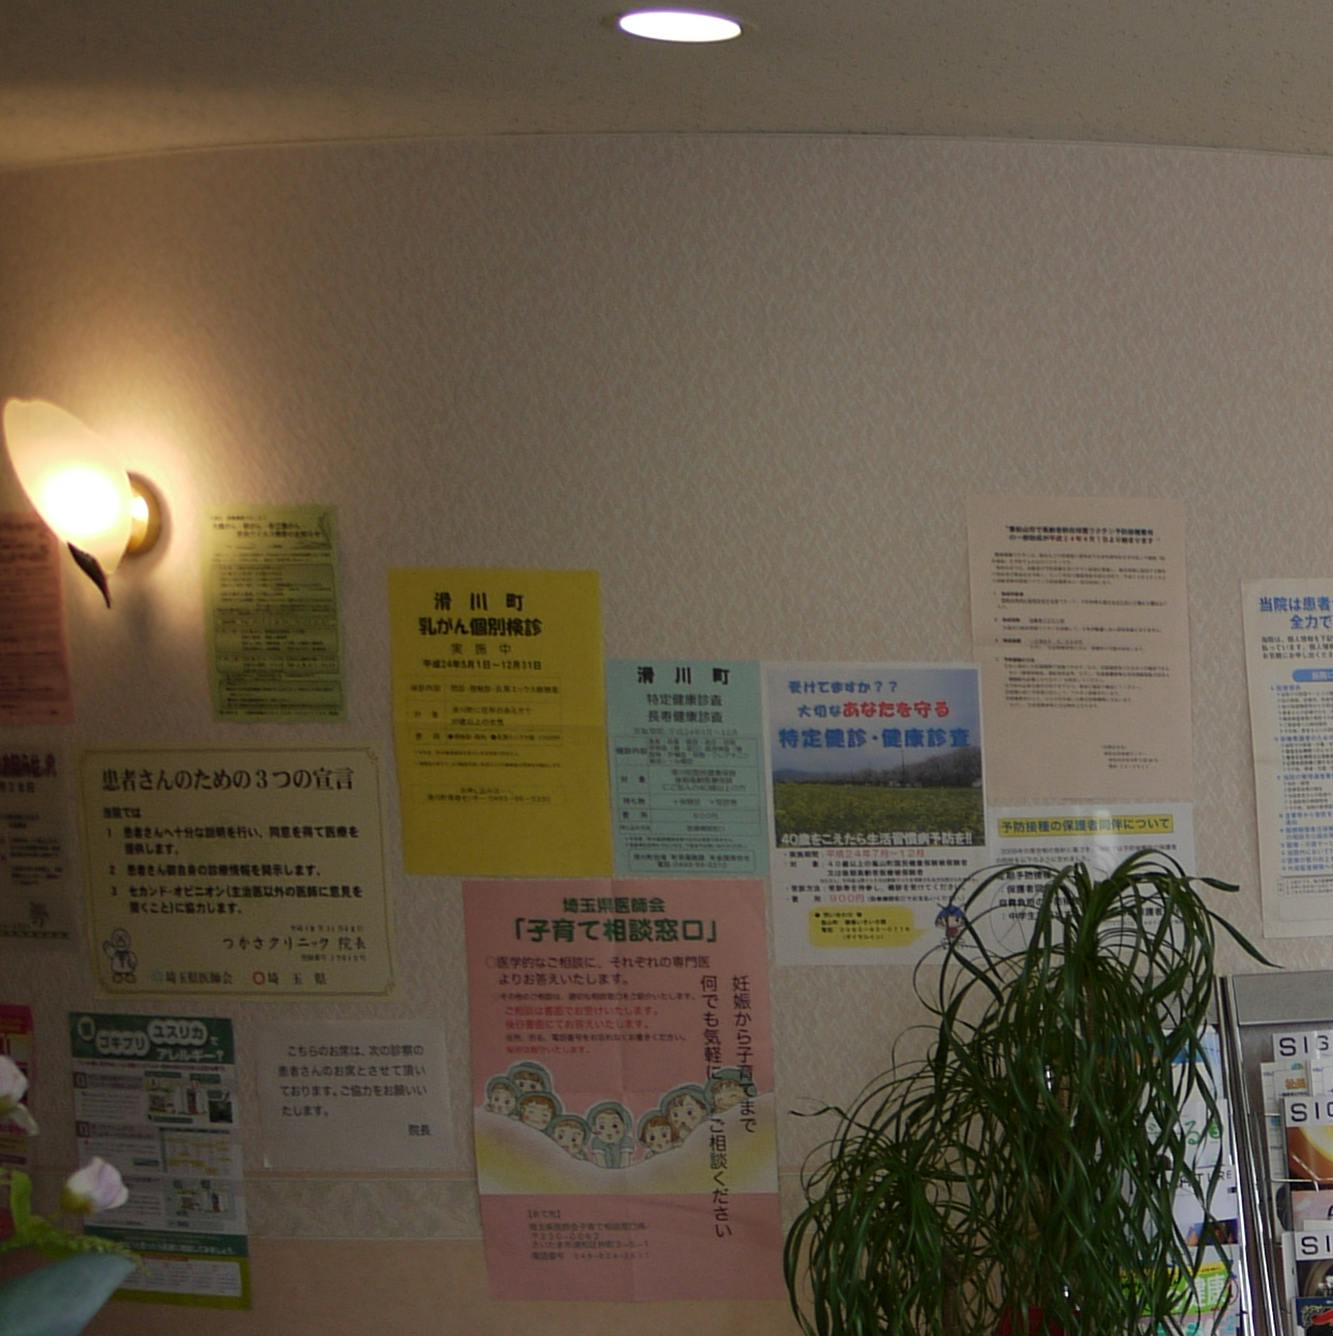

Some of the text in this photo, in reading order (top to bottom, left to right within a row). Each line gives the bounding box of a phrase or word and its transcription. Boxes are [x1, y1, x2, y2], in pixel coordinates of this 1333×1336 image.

[434, 592, 525, 611] 滑川町
[418, 617, 544, 636] 乳がん個別検診
[637, 666, 730, 685] 滑川町
[797, 700, 950, 719] 大切なあなたを守る
[778, 727, 971, 749] 特定健診・健康診査
[563, 896, 666, 914] 埼玉県医師会
[513, 917, 718, 943] 「子育て相談窓口」
[499, 973, 630, 986] よりお答えいたします。
[152, 1023, 205, 1042] ユスリカ
[99, 1034, 146, 1053] ゴキブリ
[732, 974, 758, 1134] 妊娠から子育てまで
[708, 1116, 733, 1239] ご相談ください
